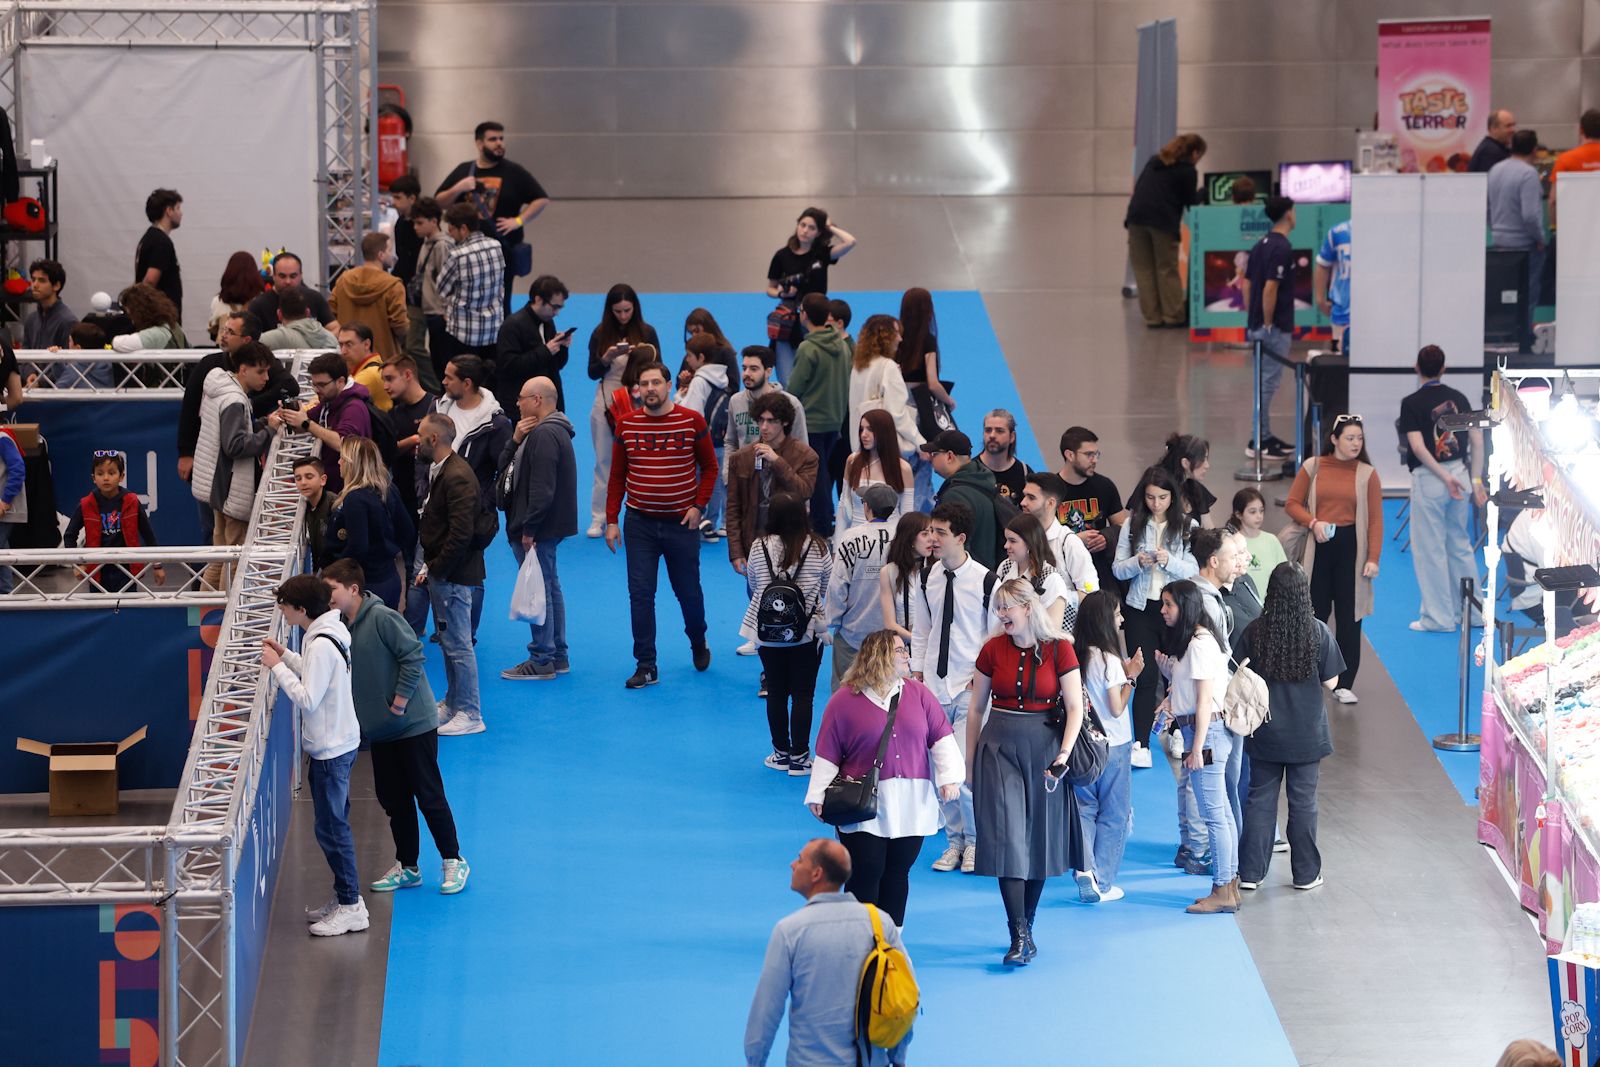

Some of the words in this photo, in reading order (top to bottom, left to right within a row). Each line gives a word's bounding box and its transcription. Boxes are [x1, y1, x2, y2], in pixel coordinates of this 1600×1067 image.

[1399, 87, 1468, 113] TASTE
[634, 431, 685, 450] 1979
[838, 535, 877, 569] Harry
[878, 528, 891, 560] P
[1565, 1012, 1580, 1025] POP
[1564, 1021, 1586, 1036] CORN
